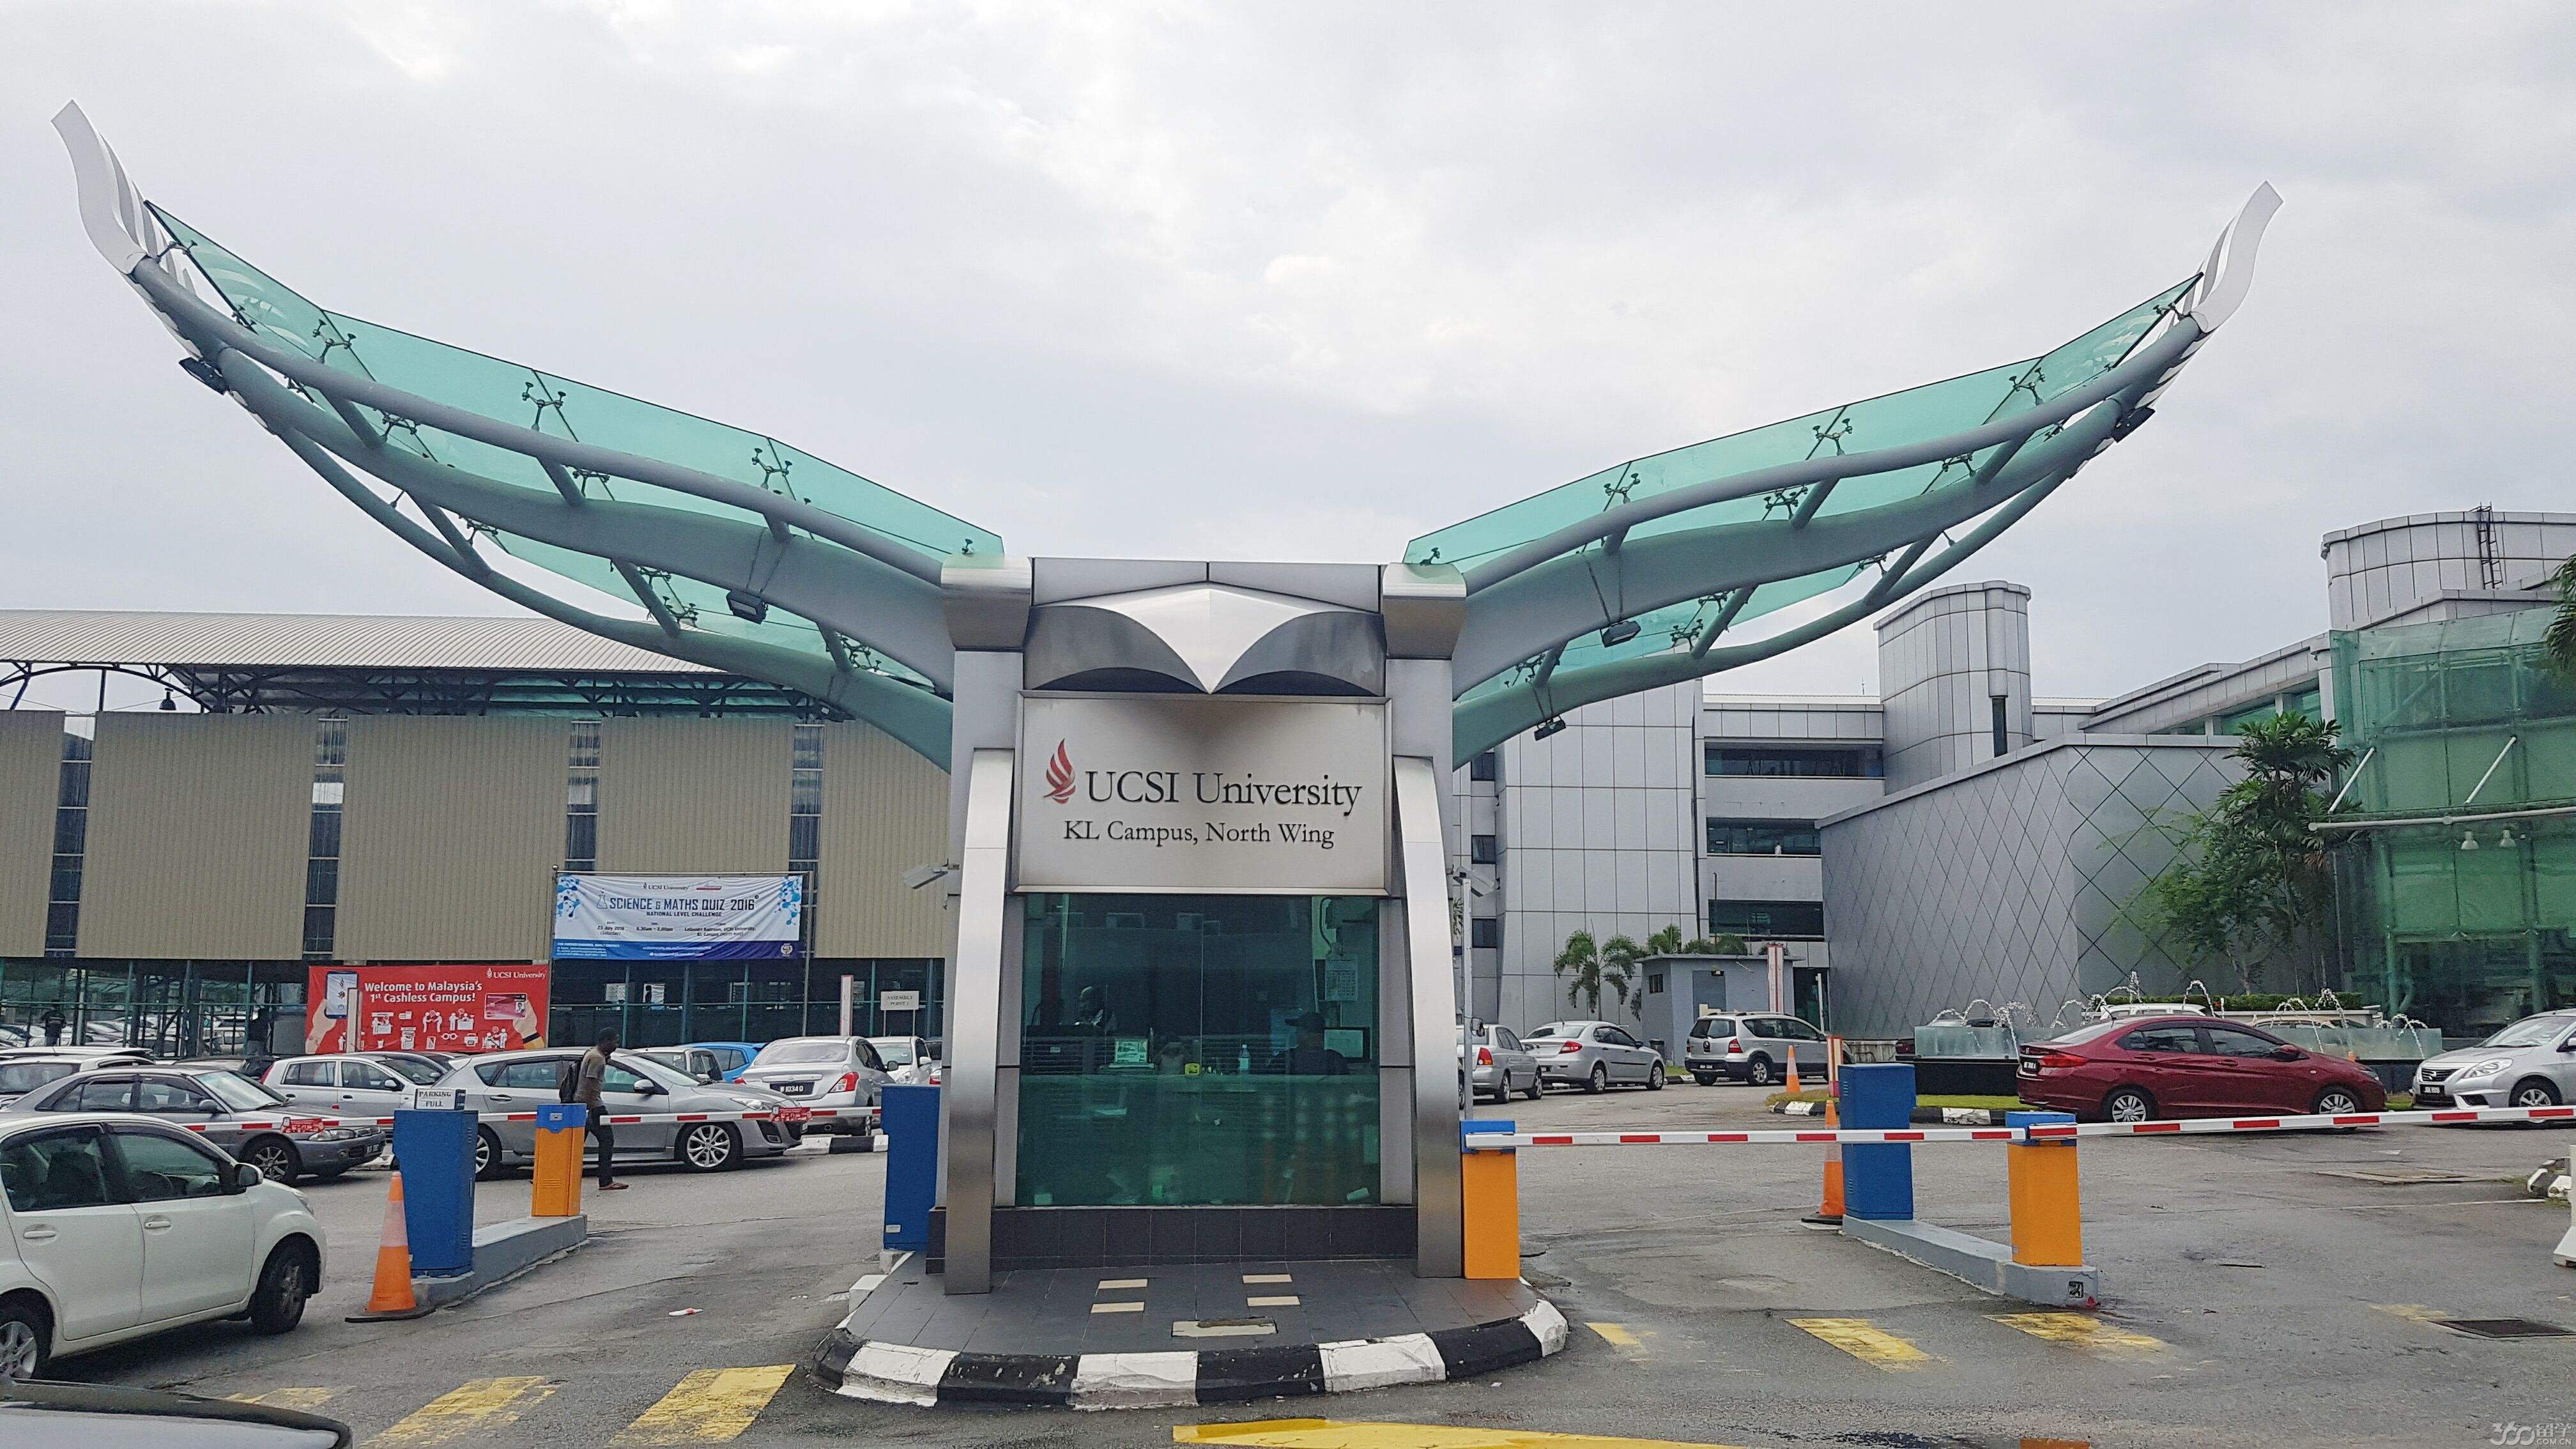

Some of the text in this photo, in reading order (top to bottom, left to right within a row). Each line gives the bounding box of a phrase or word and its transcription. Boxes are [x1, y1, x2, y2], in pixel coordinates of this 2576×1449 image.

[1084, 770, 1363, 816] UCSI University
[1063, 820, 1335, 850] KL Campus, North Wing
[610, 898, 652, 910] SCIENCE
[664, 898, 699, 910] MATHS
[702, 899, 725, 910] QUIZ
[730, 899, 755, 910] 2016
[513, 971, 545, 979] University
[364, 980, 482, 993] Welcome to Malaysia's
[370, 992, 476, 1004] 1st Cashless Campus!
